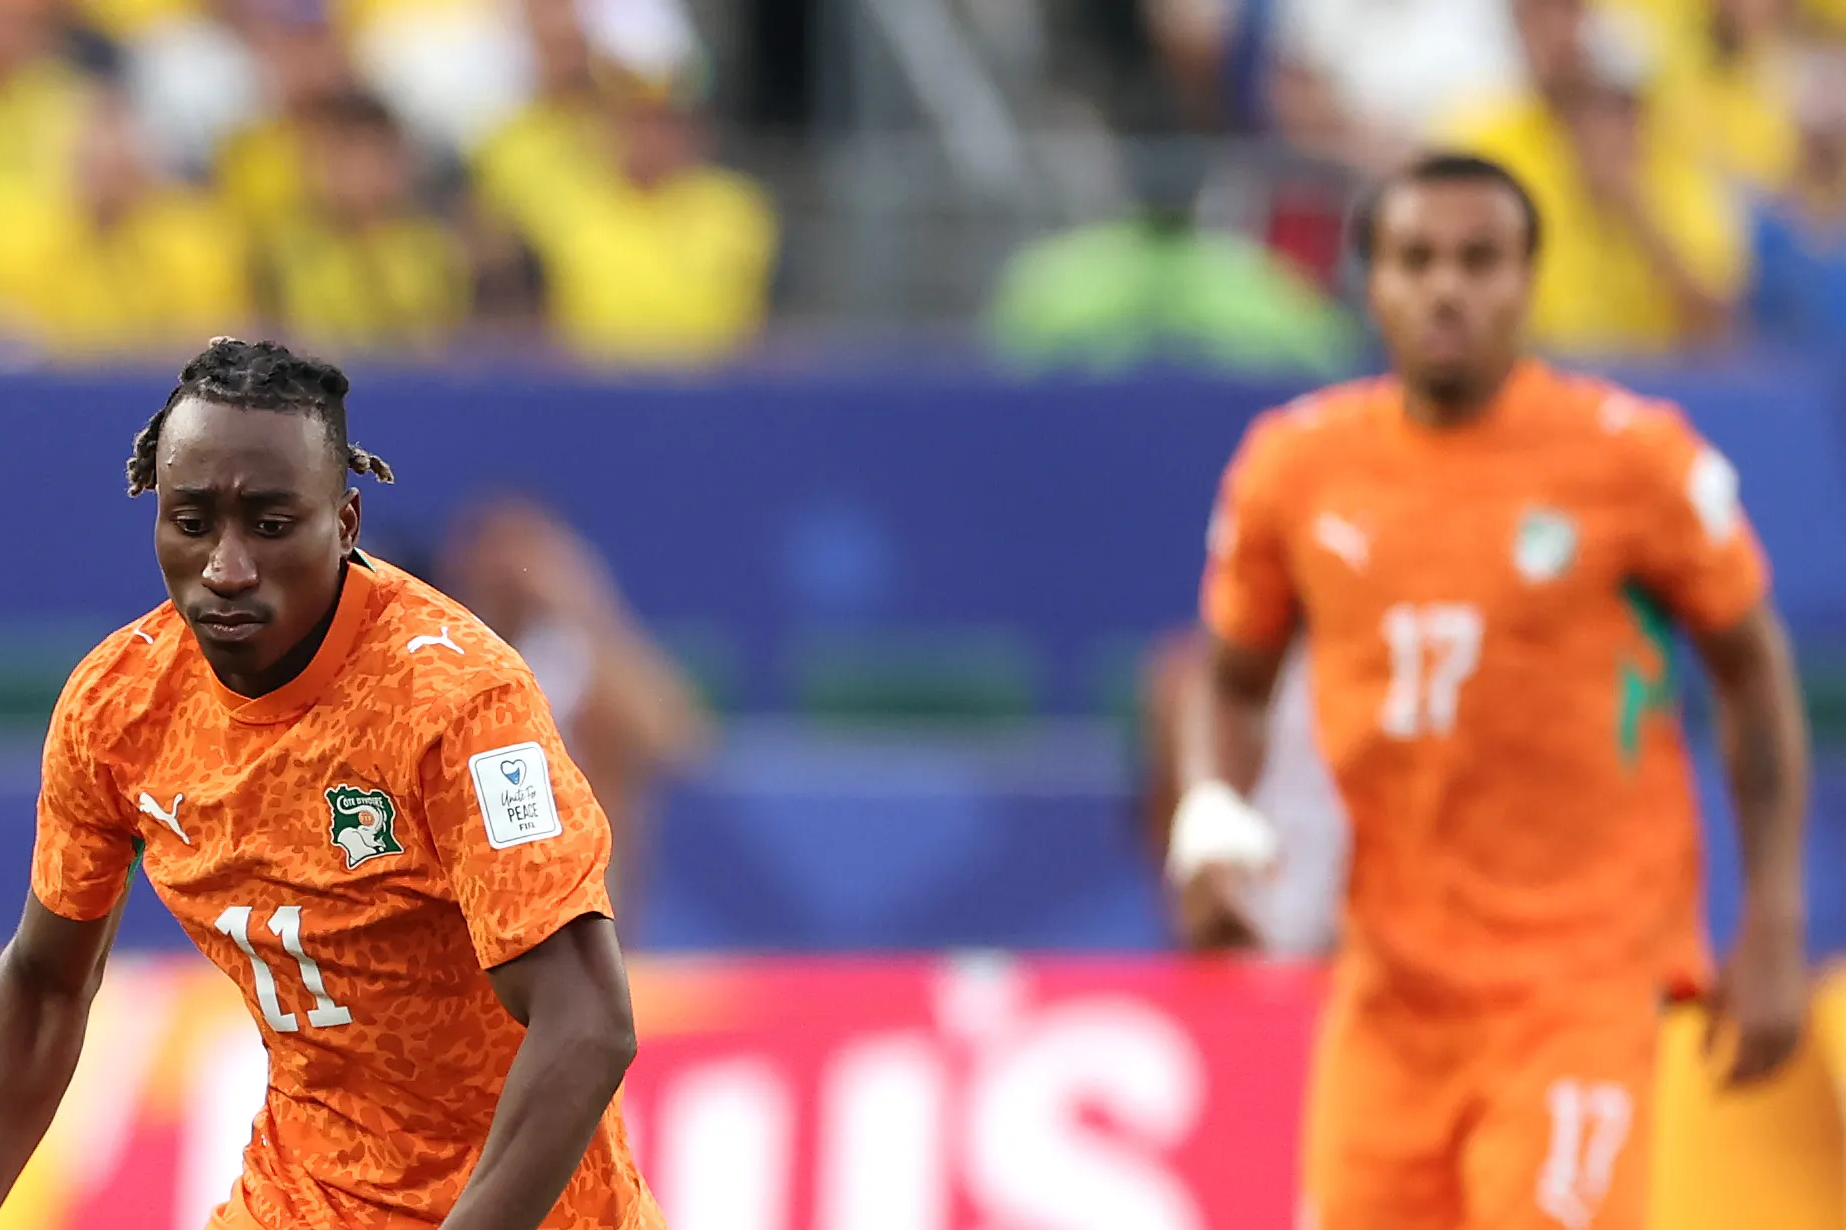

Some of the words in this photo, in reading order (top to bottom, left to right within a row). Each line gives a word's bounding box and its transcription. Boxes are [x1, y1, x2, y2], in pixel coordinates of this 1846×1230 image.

[1379, 603, 1485, 739] 17
[507, 802, 539, 822] PEACE
[213, 905, 353, 1033] 11
[1544, 1077, 1633, 1202] 17
